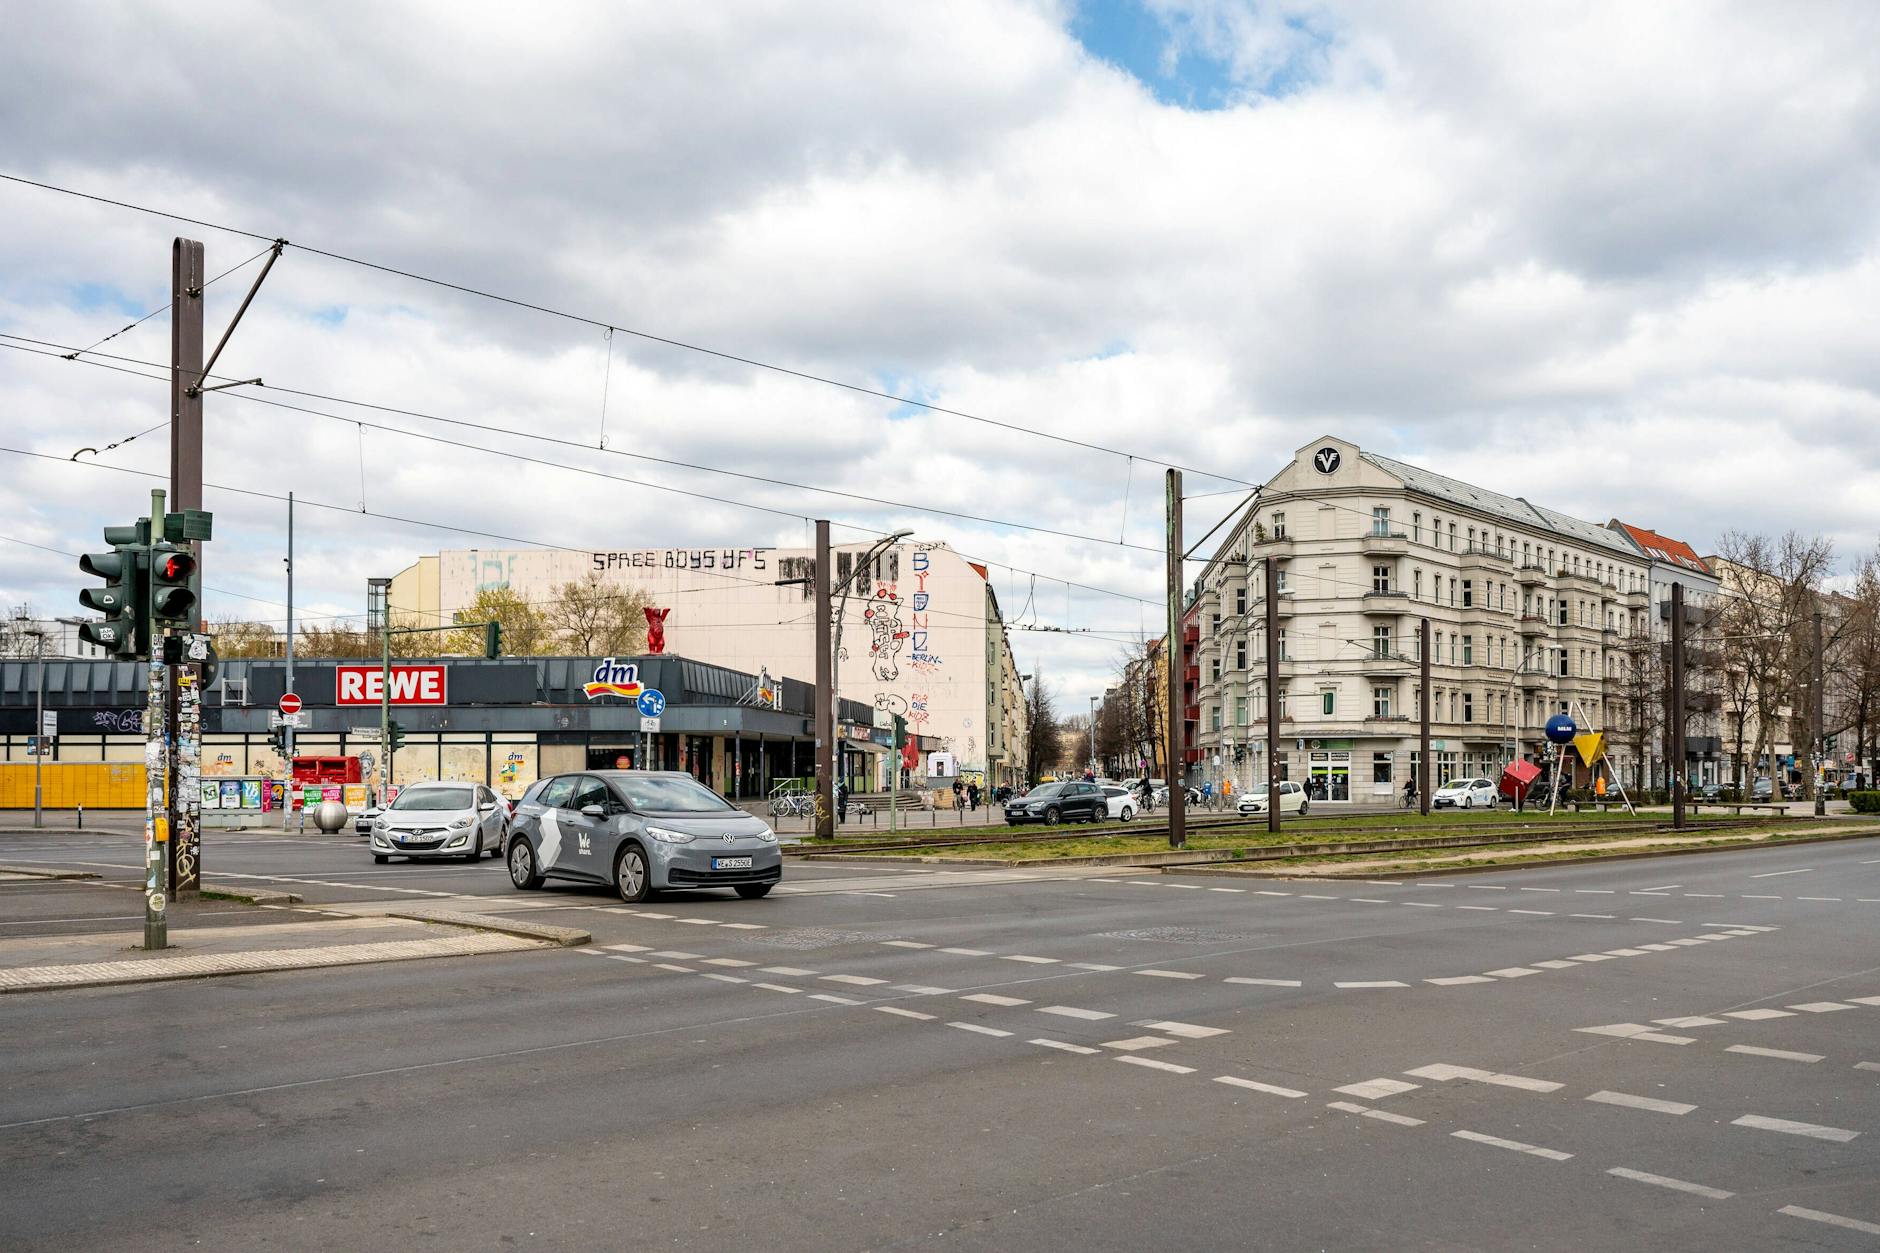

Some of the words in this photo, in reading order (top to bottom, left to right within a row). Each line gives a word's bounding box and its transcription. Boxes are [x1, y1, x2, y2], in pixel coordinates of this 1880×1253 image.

[595, 660, 635, 683] dm
[341, 671, 441, 700] REWE
[217, 753, 232, 761] dm
[508, 752, 523, 760] dm
[579, 833, 591, 849] We
